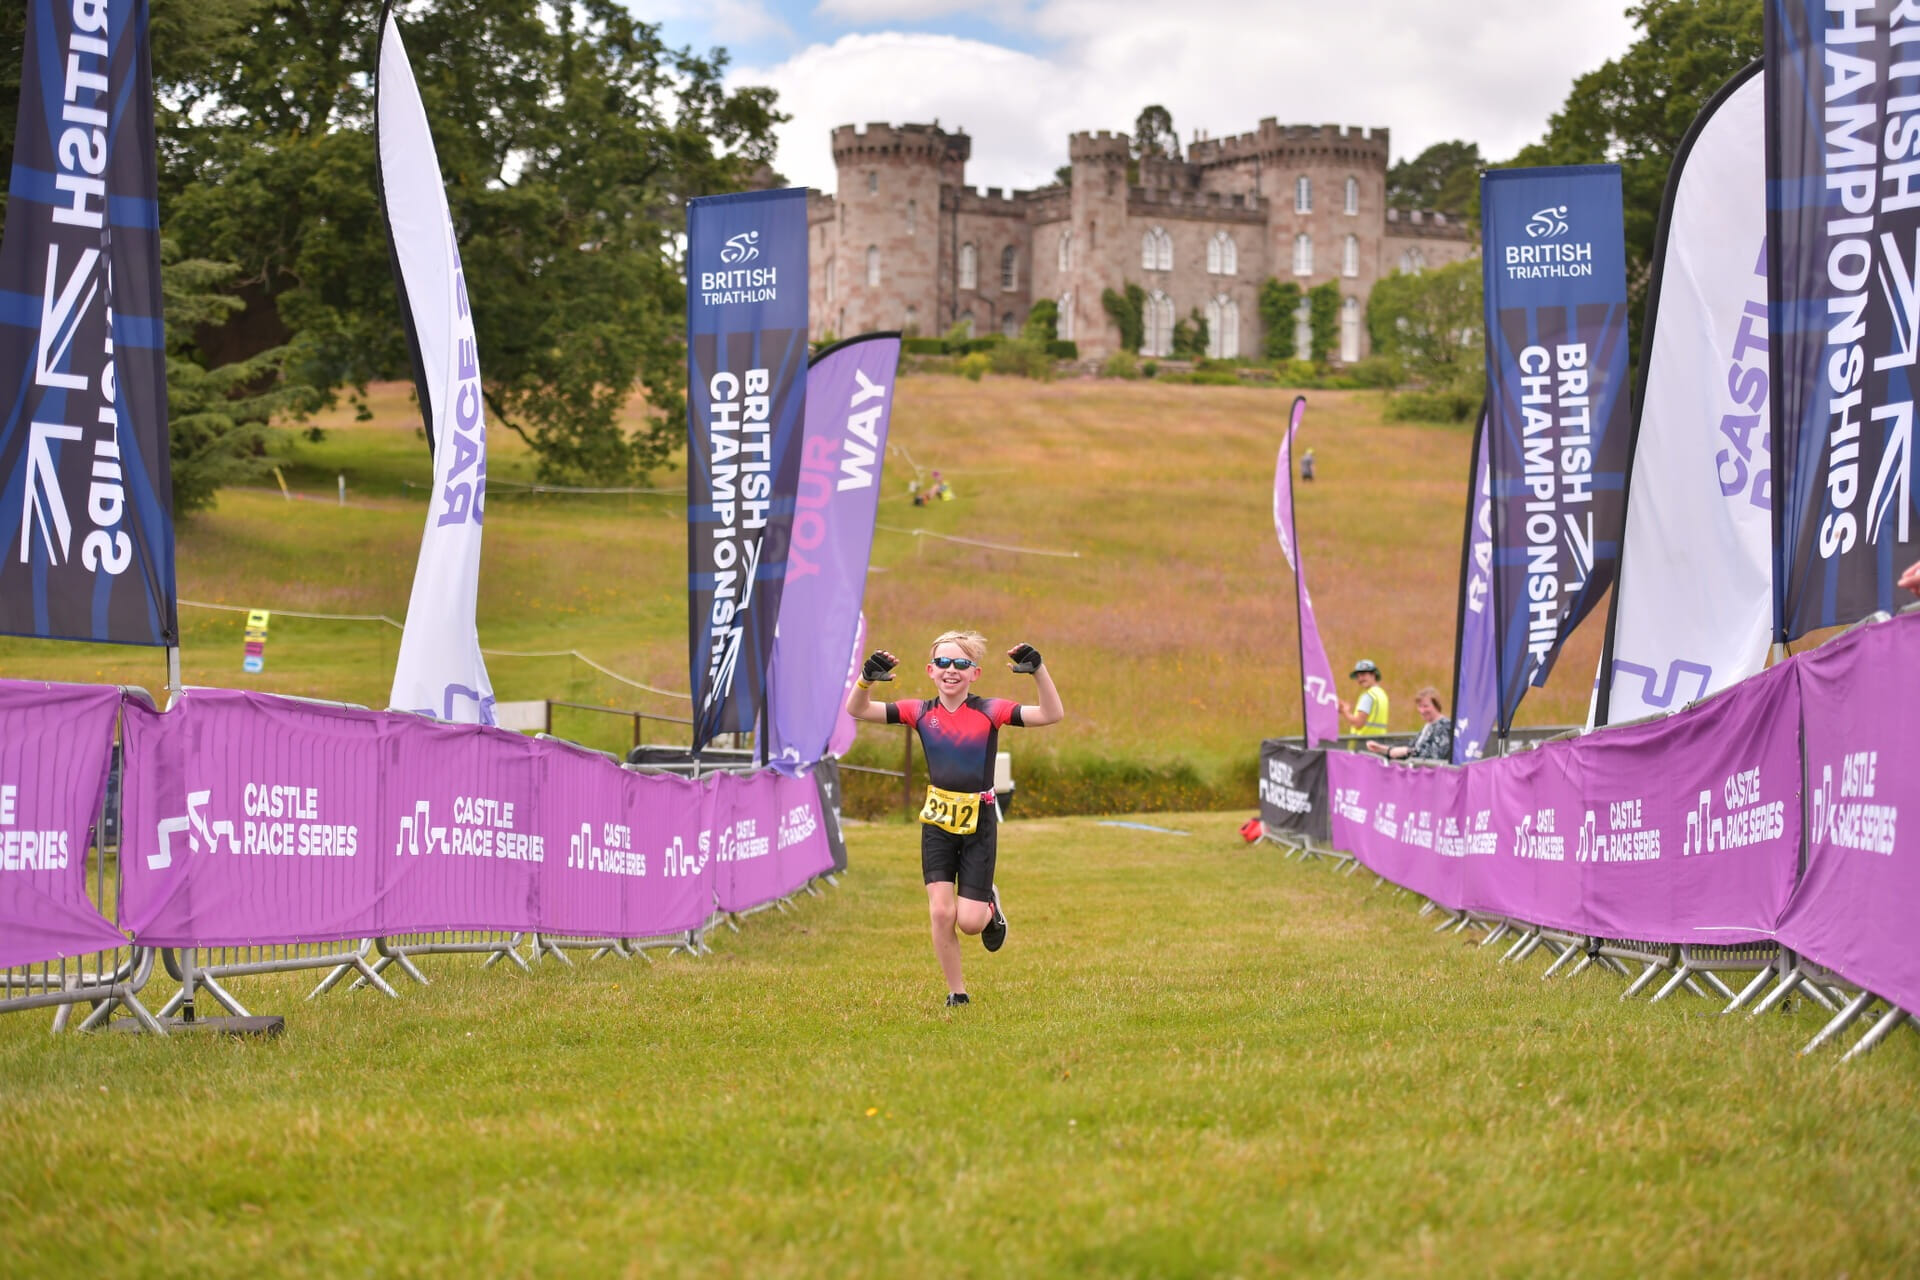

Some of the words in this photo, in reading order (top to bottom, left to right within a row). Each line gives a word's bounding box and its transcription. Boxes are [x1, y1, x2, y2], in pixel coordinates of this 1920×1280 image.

[1505, 243, 1592, 265] BRITISH
[1506, 263, 1593, 280] TRIATHLON
[701, 267, 777, 290] BRITISH
[701, 287, 777, 306] TRIATHLON
[1819, 0, 1877, 559] HAMPIONSHIPS
[836, 368, 886, 492] WAY
[1556, 343, 1593, 503] BRITISH
[740, 368, 771, 529] BRITISH
[784, 433, 841, 585] YOUR
[1519, 345, 1559, 688] CHAMPIONSHIP
[1723, 766, 1761, 811] CASTLE
[1840, 751, 1878, 798] CASTLE
[243, 782, 318, 820] CASTLE
[453, 796, 514, 829] CASTLE
[924, 798, 973, 829] 3212
[1609, 798, 1643, 831] CASTLE
[243, 823, 295, 857] RACE
[298, 823, 358, 857] SERIES
[603, 822, 631, 850] CASTLE
[1724, 814, 1750, 851] RACE
[1749, 800, 1785, 845] SERIES
[1860, 804, 1898, 856] SERIES
[451, 827, 494, 857] RACE
[495, 832, 544, 863] SERIES
[603, 848, 626, 875] RACE
[1609, 832, 1634, 863] RACE
[1633, 828, 1661, 861] SERIES
